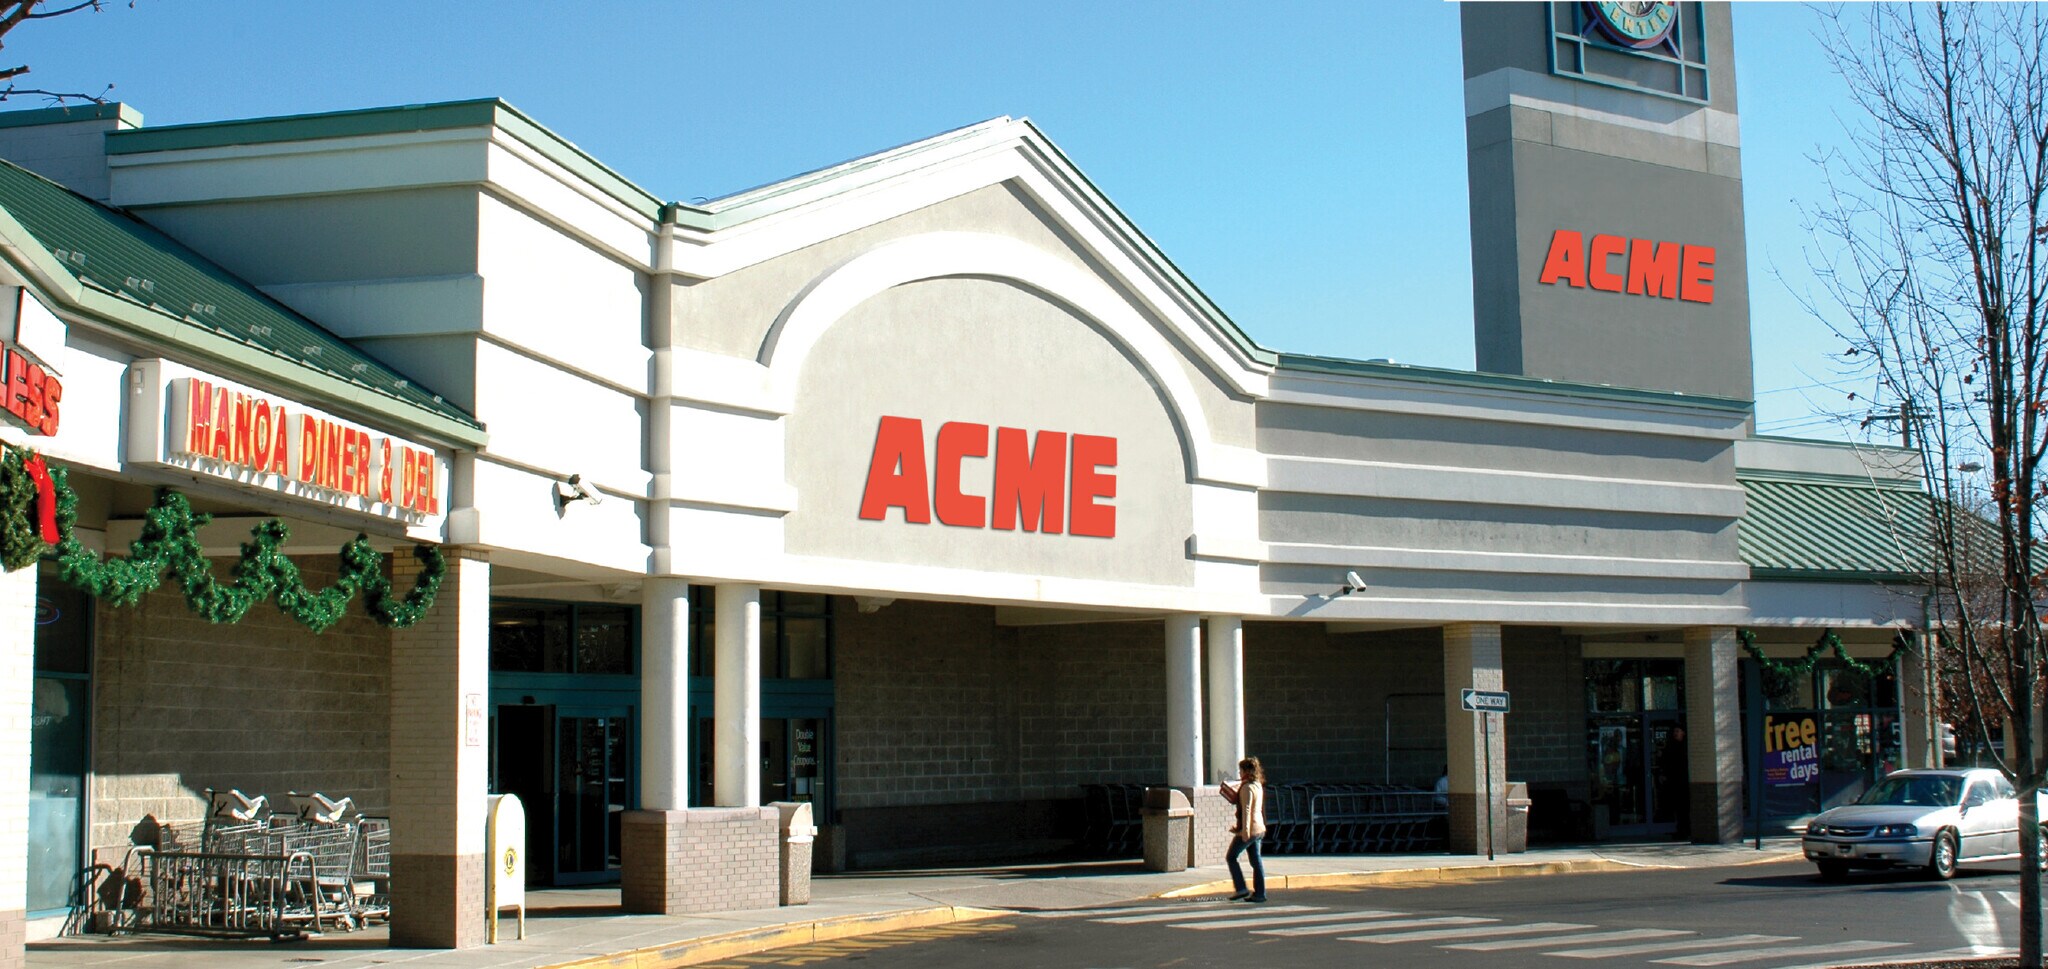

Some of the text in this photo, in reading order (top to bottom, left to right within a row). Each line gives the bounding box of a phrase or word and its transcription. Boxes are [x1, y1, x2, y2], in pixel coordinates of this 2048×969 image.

[1539, 229, 1716, 304] ACME
[187, 377, 439, 515] MANOA DINER & DEL
[858, 415, 1117, 538] ACME
[1475, 696, 1504, 706] ONE WAY
[1765, 715, 1816, 753] free
[1781, 743, 1817, 764] rental
[1790, 763, 1818, 781] days
